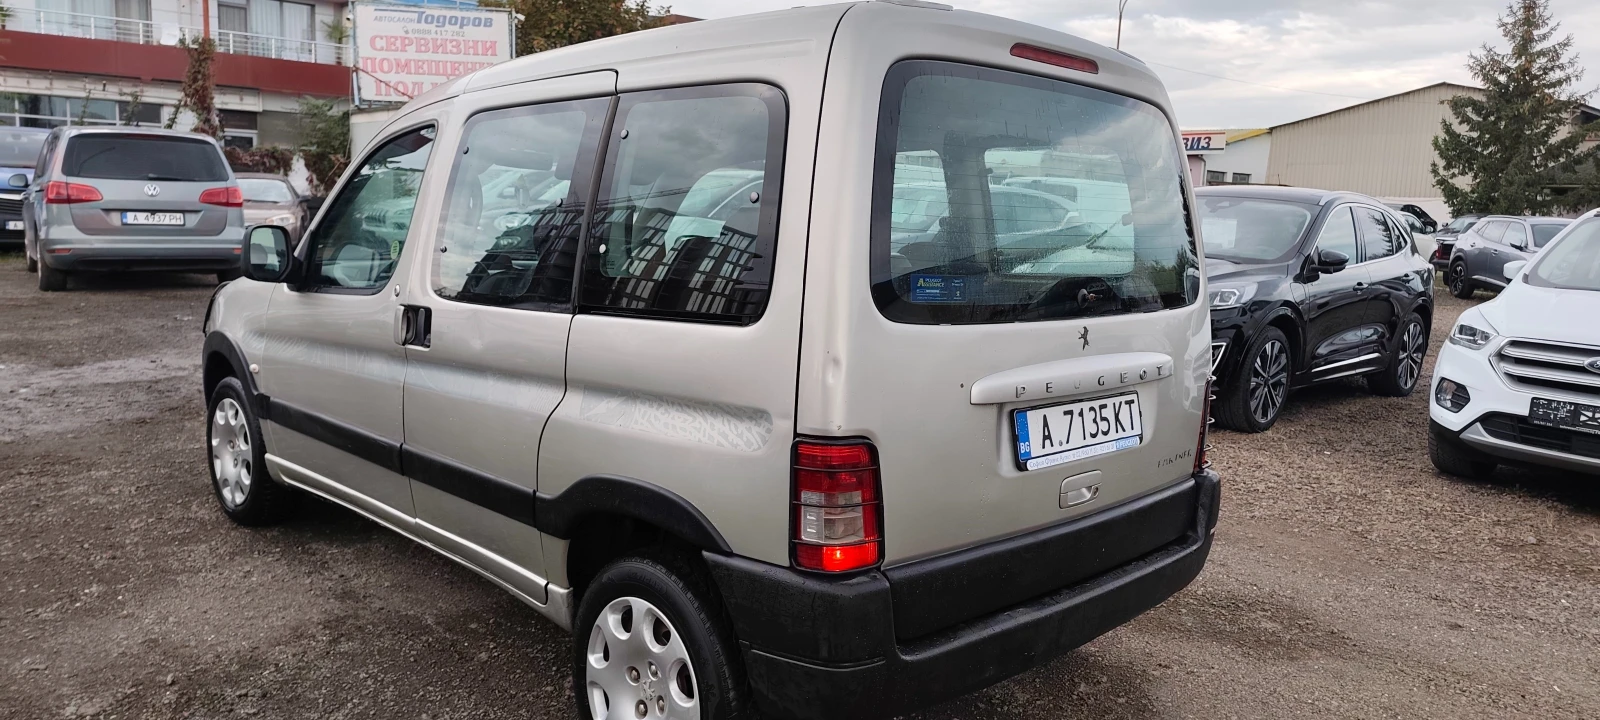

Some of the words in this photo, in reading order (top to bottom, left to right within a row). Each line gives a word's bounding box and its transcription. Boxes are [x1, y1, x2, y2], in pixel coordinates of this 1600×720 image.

[373, 15, 415, 24] АВТОСАЛОН
[415, 10, 494, 30] Тодоров
[411, 28, 432, 36] 0888
[369, 35, 498, 56] СЕРВИЗНИ
[1016, 364, 1164, 398] PEUGEOT
[1020, 441, 1030, 453] BG
